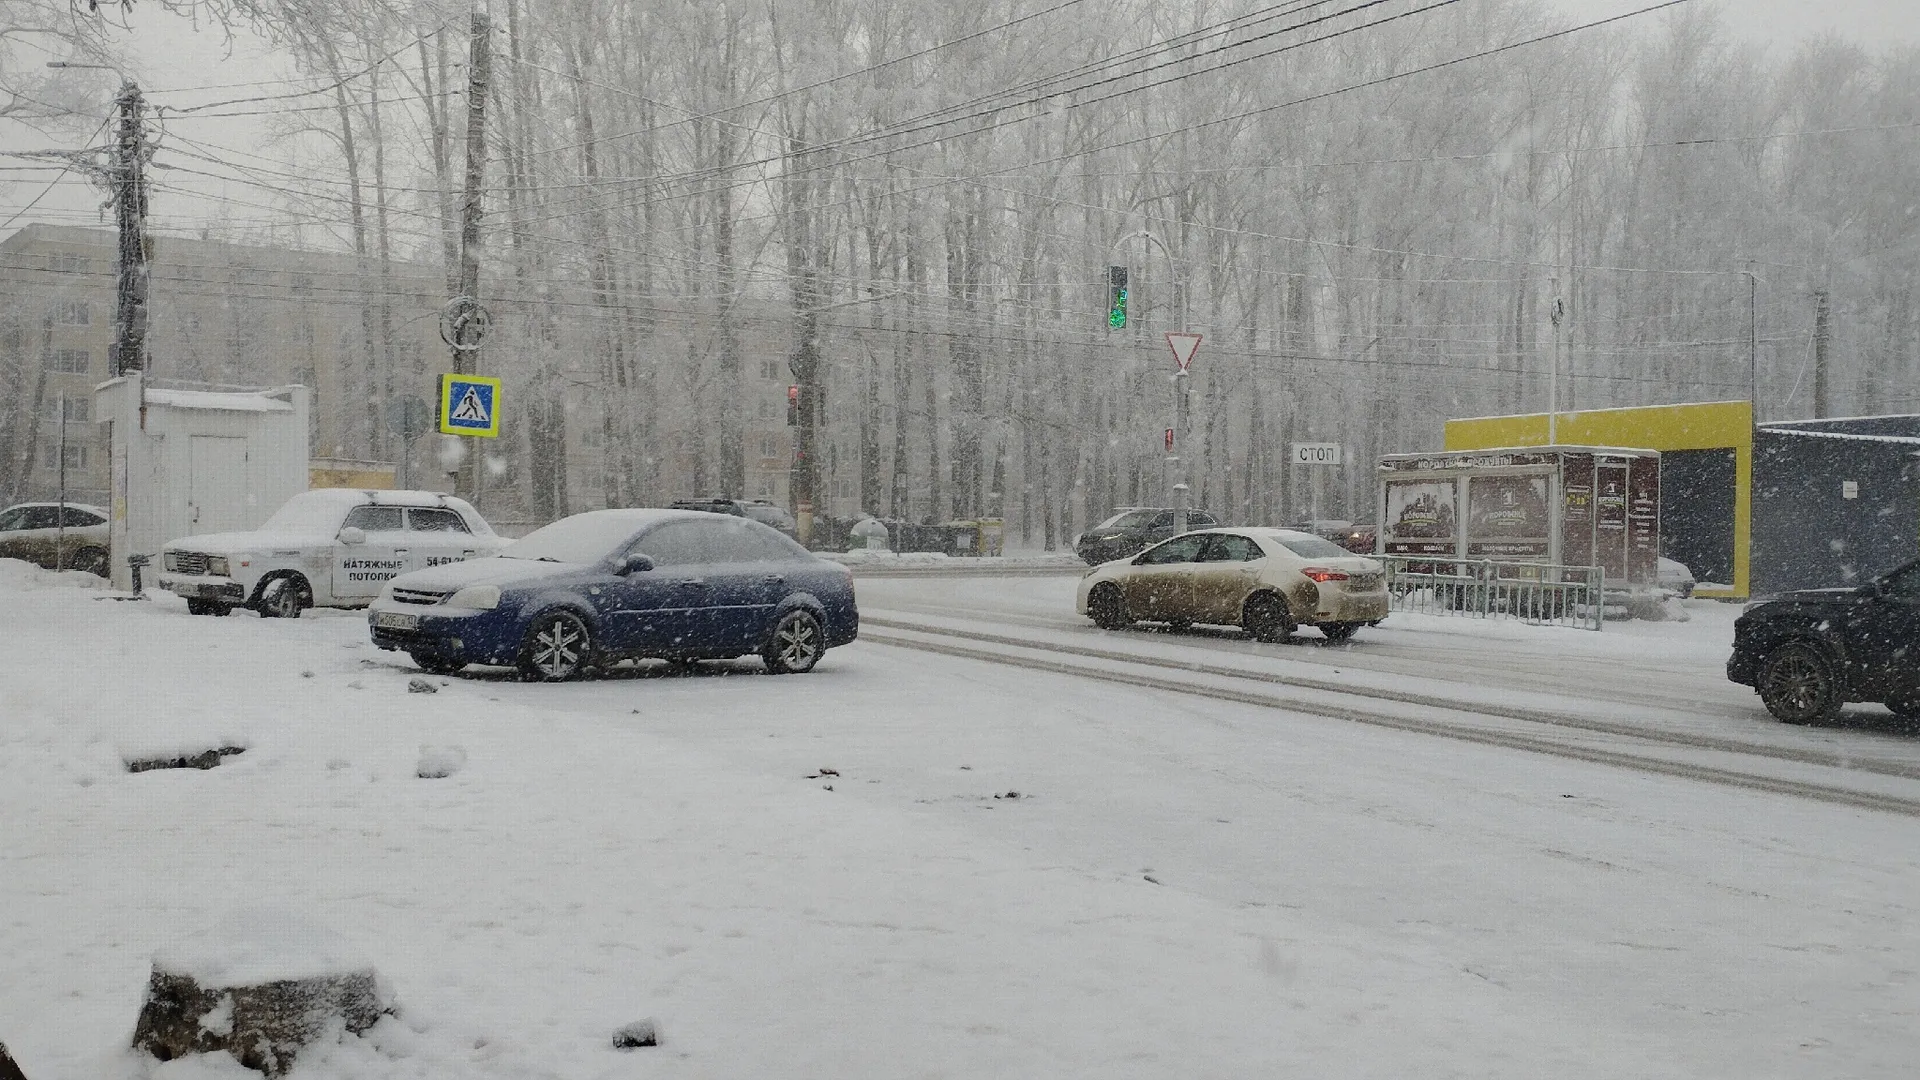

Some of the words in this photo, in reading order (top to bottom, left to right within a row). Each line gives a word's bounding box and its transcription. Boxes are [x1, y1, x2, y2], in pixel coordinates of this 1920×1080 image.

[1300, 447, 1334, 461] СТОП
[343, 559, 402, 569] НАТЯЖНЫЕ
[349, 572, 397, 581] ПОТОЛКИ
